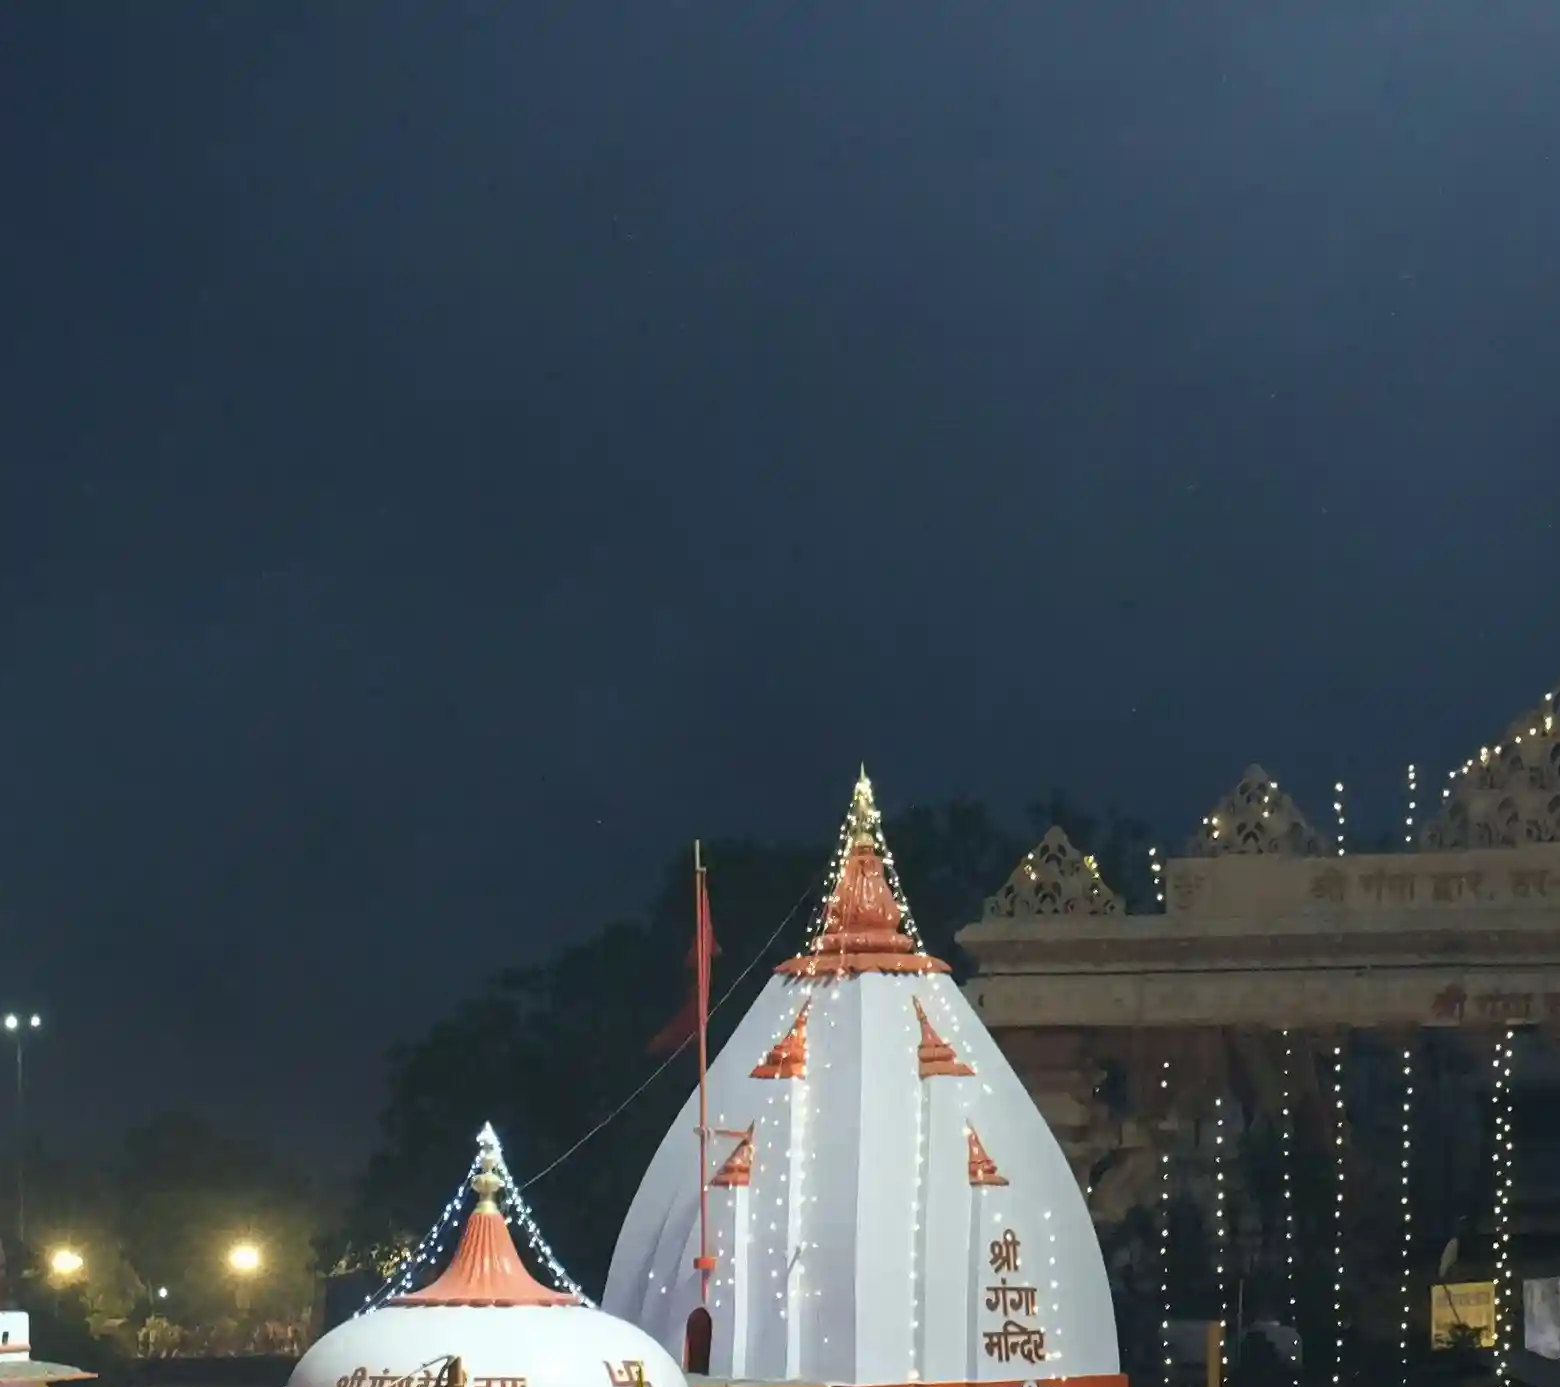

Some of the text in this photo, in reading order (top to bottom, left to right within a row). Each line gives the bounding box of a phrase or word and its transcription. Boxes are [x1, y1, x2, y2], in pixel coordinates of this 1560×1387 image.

[989, 1228, 1021, 1274] श्री
[985, 1278, 1038, 1317] गंगा
[982, 1319, 1048, 1364] मन्दिर
